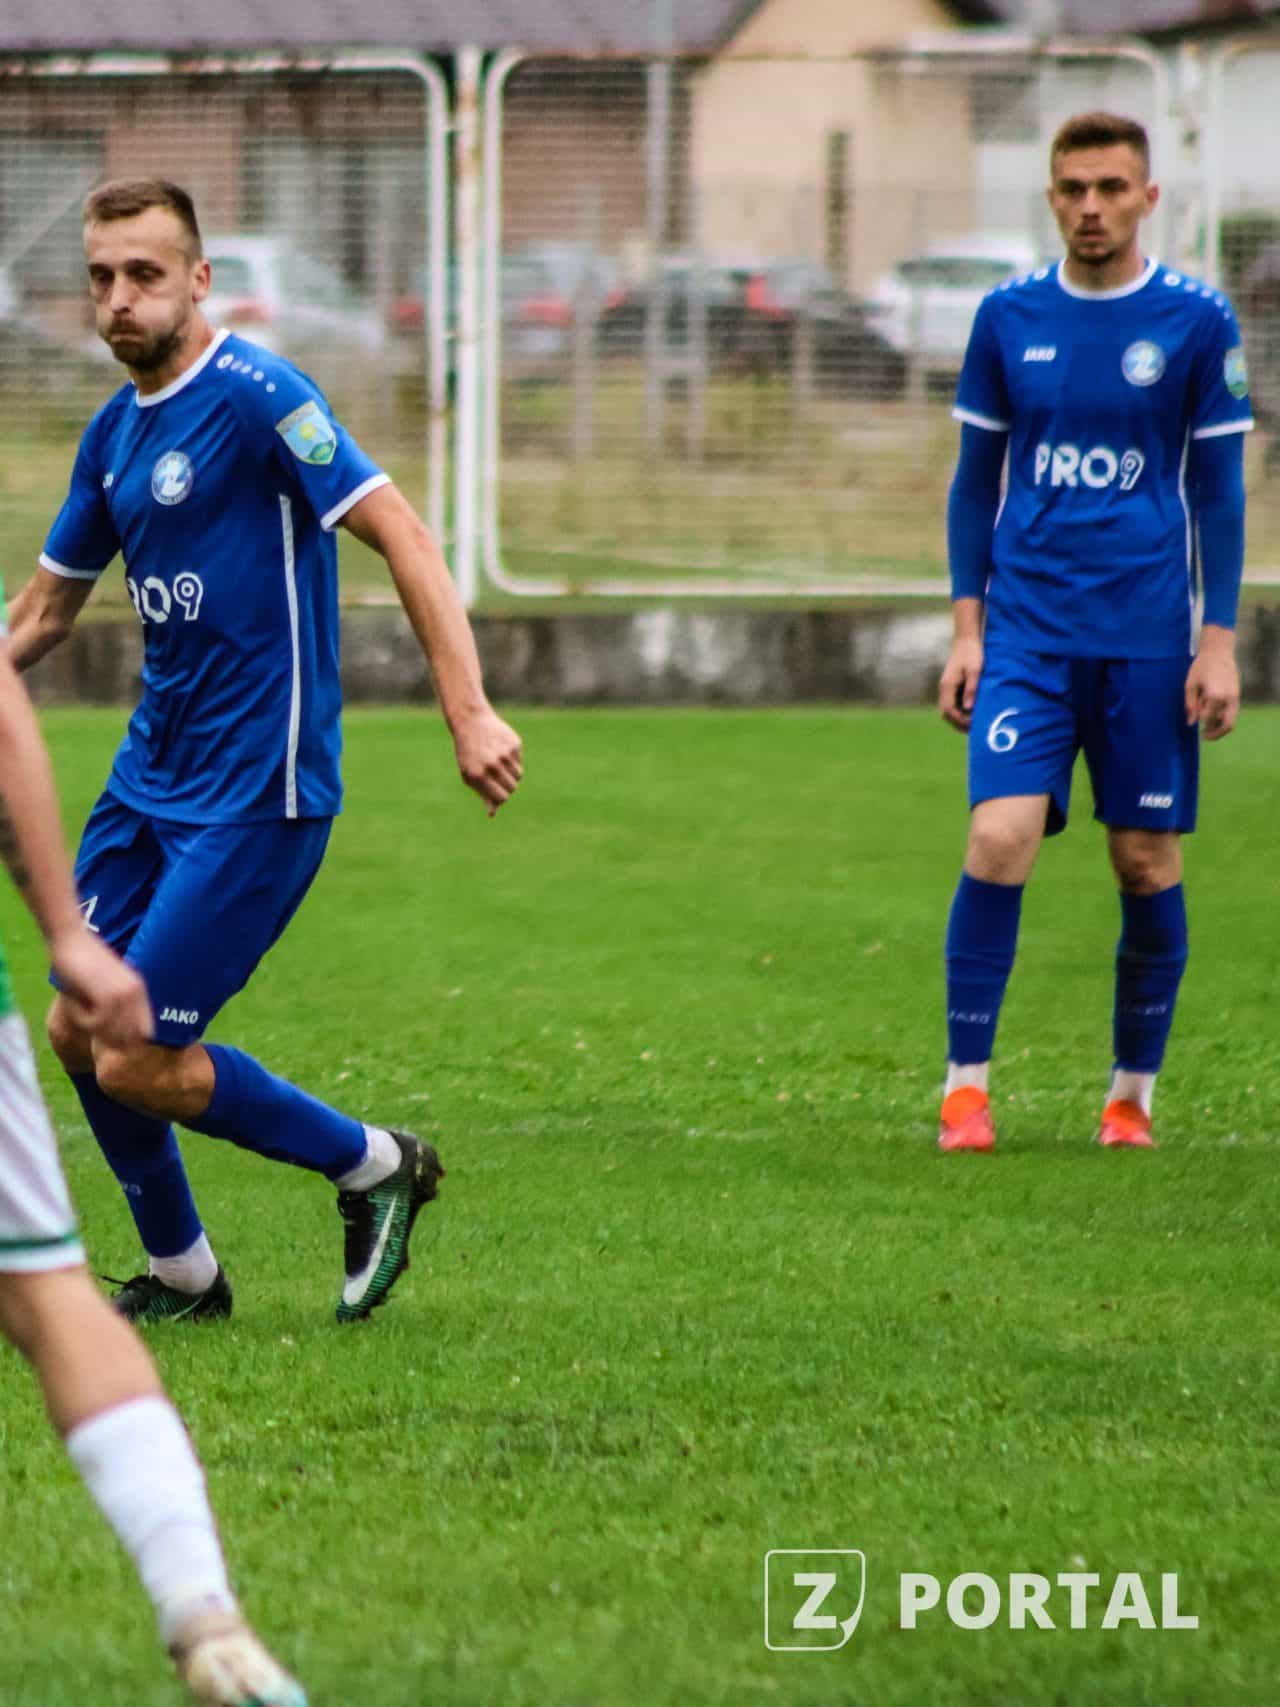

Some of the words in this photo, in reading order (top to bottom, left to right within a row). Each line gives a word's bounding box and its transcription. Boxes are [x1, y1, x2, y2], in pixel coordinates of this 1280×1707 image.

[1034, 443, 1145, 490] PRO9
[987, 708, 1019, 752] 6
[159, 1007, 199, 1025] JAKO
